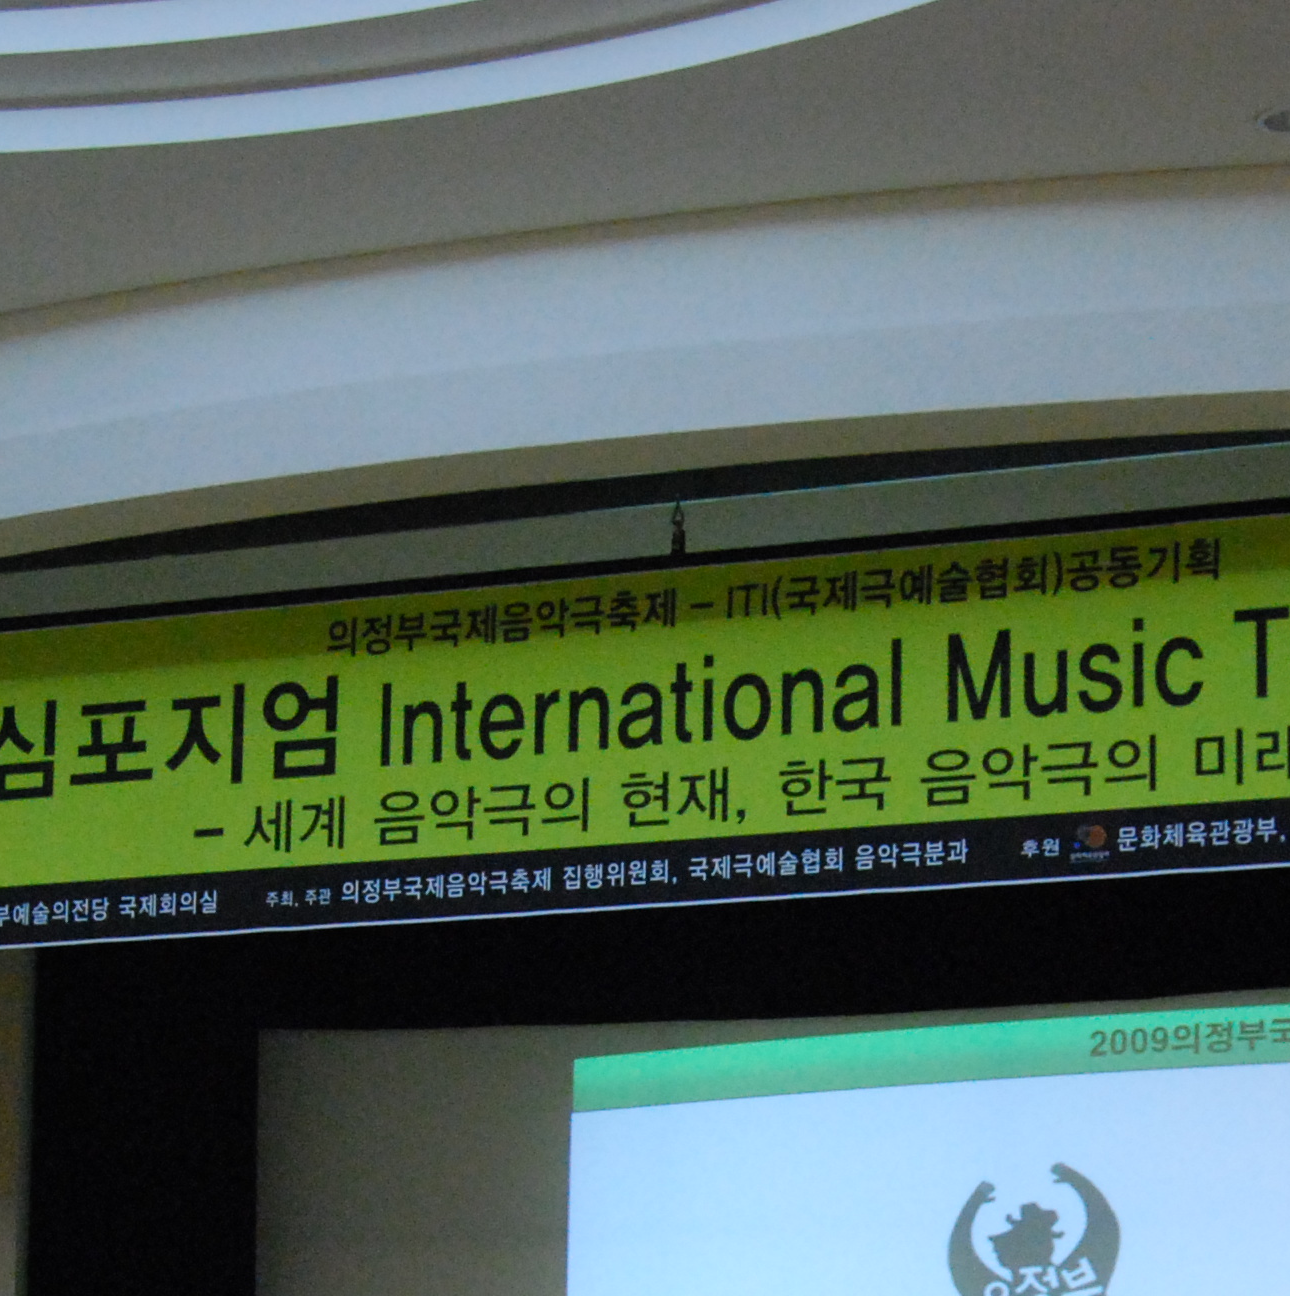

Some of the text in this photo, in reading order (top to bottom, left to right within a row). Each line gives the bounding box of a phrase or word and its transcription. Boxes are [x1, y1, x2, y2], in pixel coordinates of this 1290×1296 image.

[327, 588, 677, 656] 의정부국제음악극축제
[727, 538, 1221, 621] ITI(국제극예술협회)공동기획
[380, 638, 902, 766] International
[948, 619, 1204, 722] Music
[243, 795, 345, 853] 세계
[373, 776, 589, 846] 음악극의
[621, 769, 747, 829] 현재,
[779, 758, 891, 816] 한국
[920, 734, 1158, 808] 음악극의
[119, 889, 219, 921] 국제회의실
[305, 888, 331, 906] 주관
[341, 869, 553, 905] 의정부국제음악극축제
[563, 858, 678, 891] 집행위원회,
[687, 848, 845, 882] 국제극예술협회
[854, 840, 969, 871] 음악극분과
[1020, 835, 1060, 860] 후원
[1117, 816, 1286, 853] 문화체육관광부,
